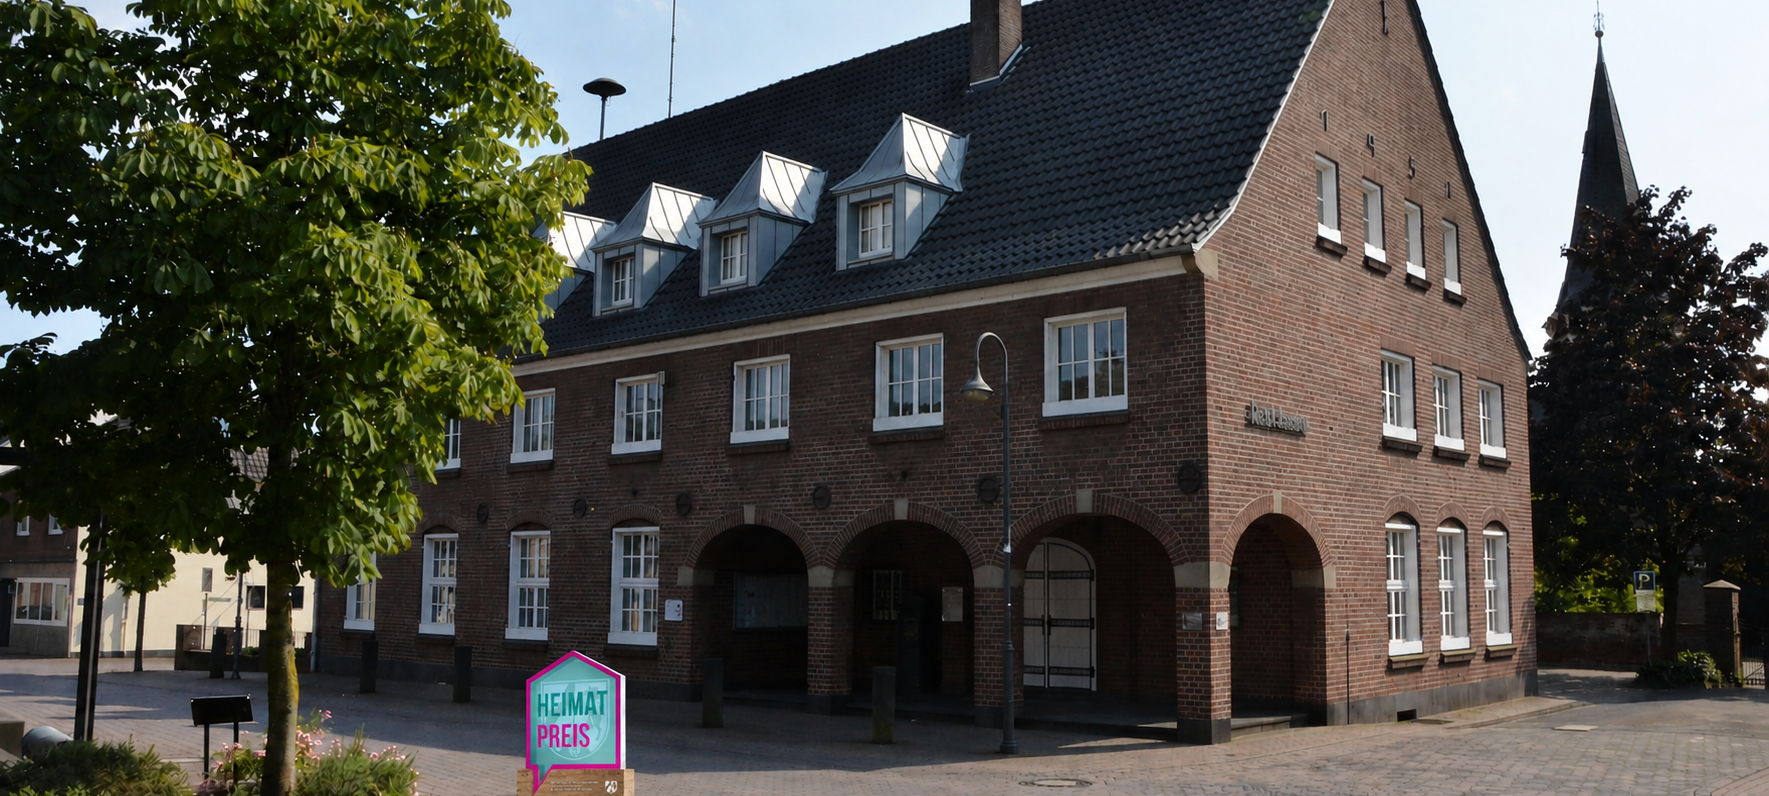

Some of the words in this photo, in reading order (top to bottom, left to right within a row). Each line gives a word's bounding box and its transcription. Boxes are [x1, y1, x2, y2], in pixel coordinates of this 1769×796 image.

[1638, 573, 1650, 589] P
[537, 690, 608, 717] HEIMAT
[537, 723, 590, 748] PREIS
